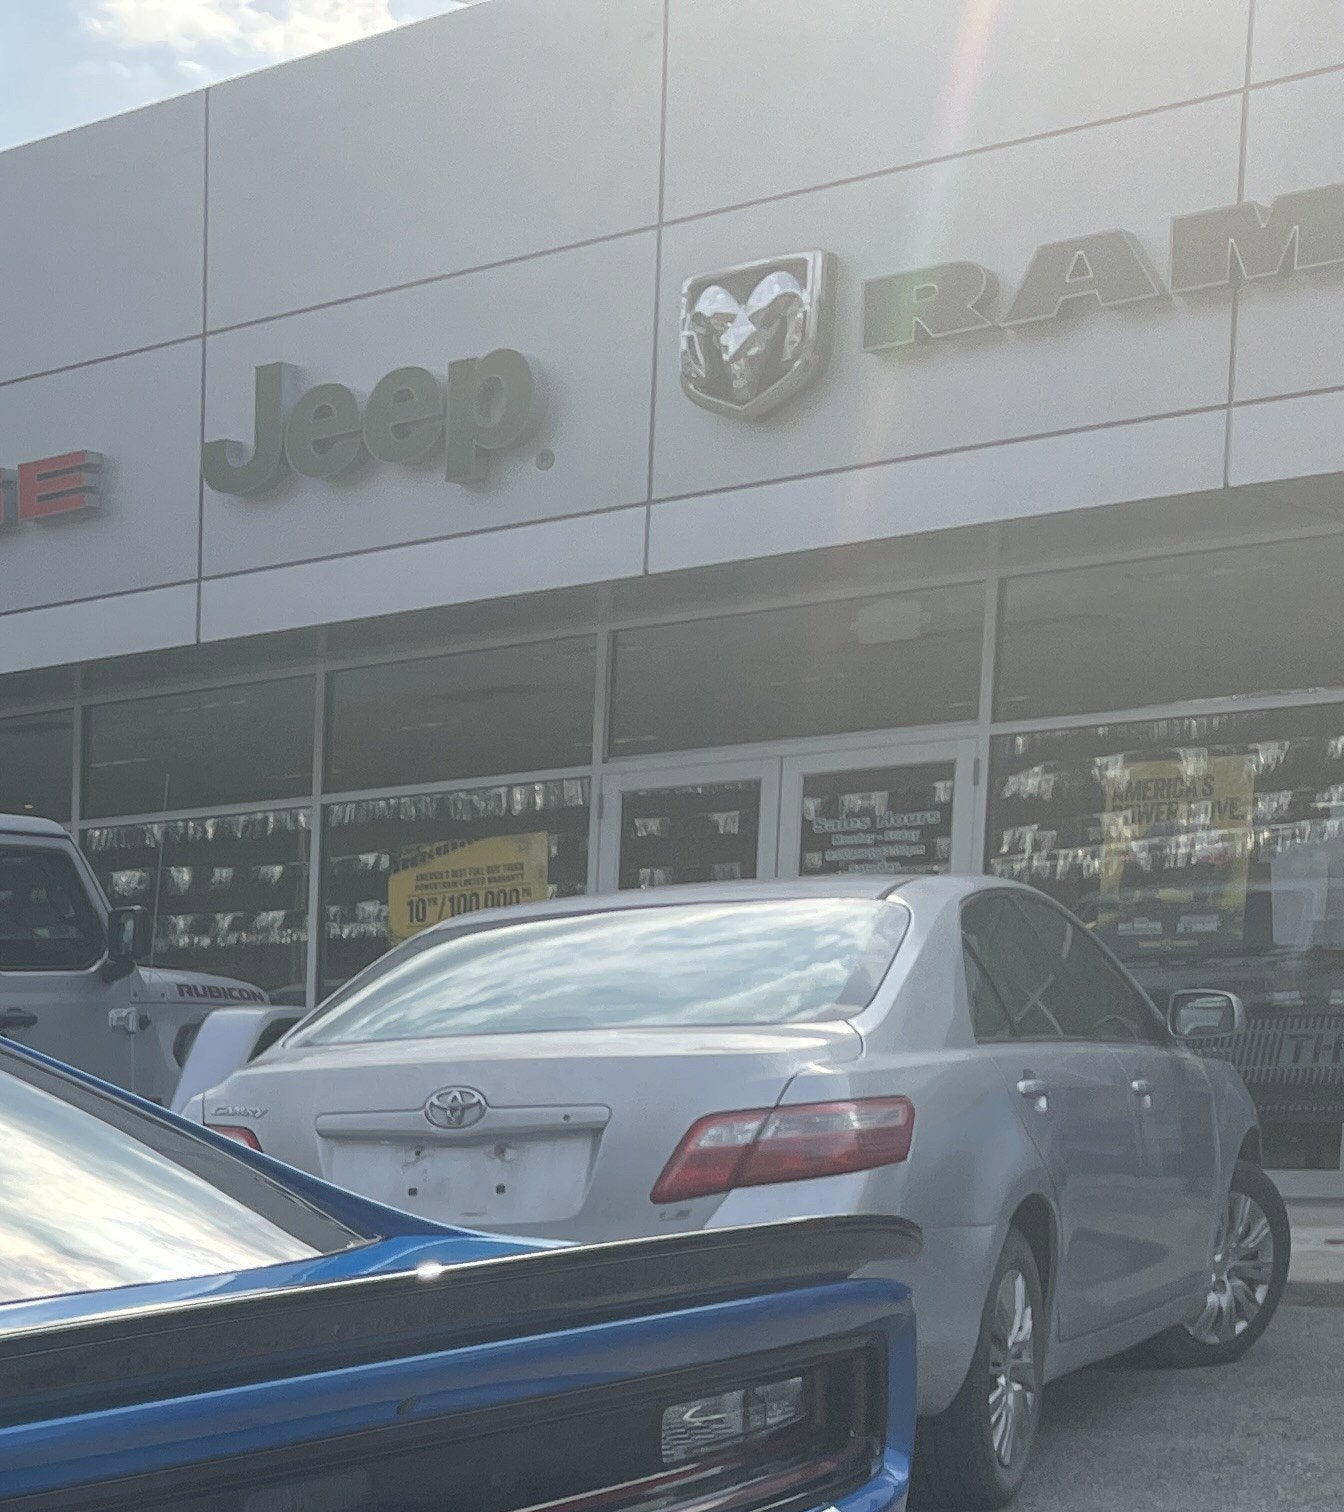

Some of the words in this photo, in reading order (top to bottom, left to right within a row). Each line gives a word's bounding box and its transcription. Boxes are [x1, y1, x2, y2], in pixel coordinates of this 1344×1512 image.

[861, 182, 1344, 353] RAM
[202, 348, 536, 493] Jeep
[176, 983, 265, 1001] RUBICON
